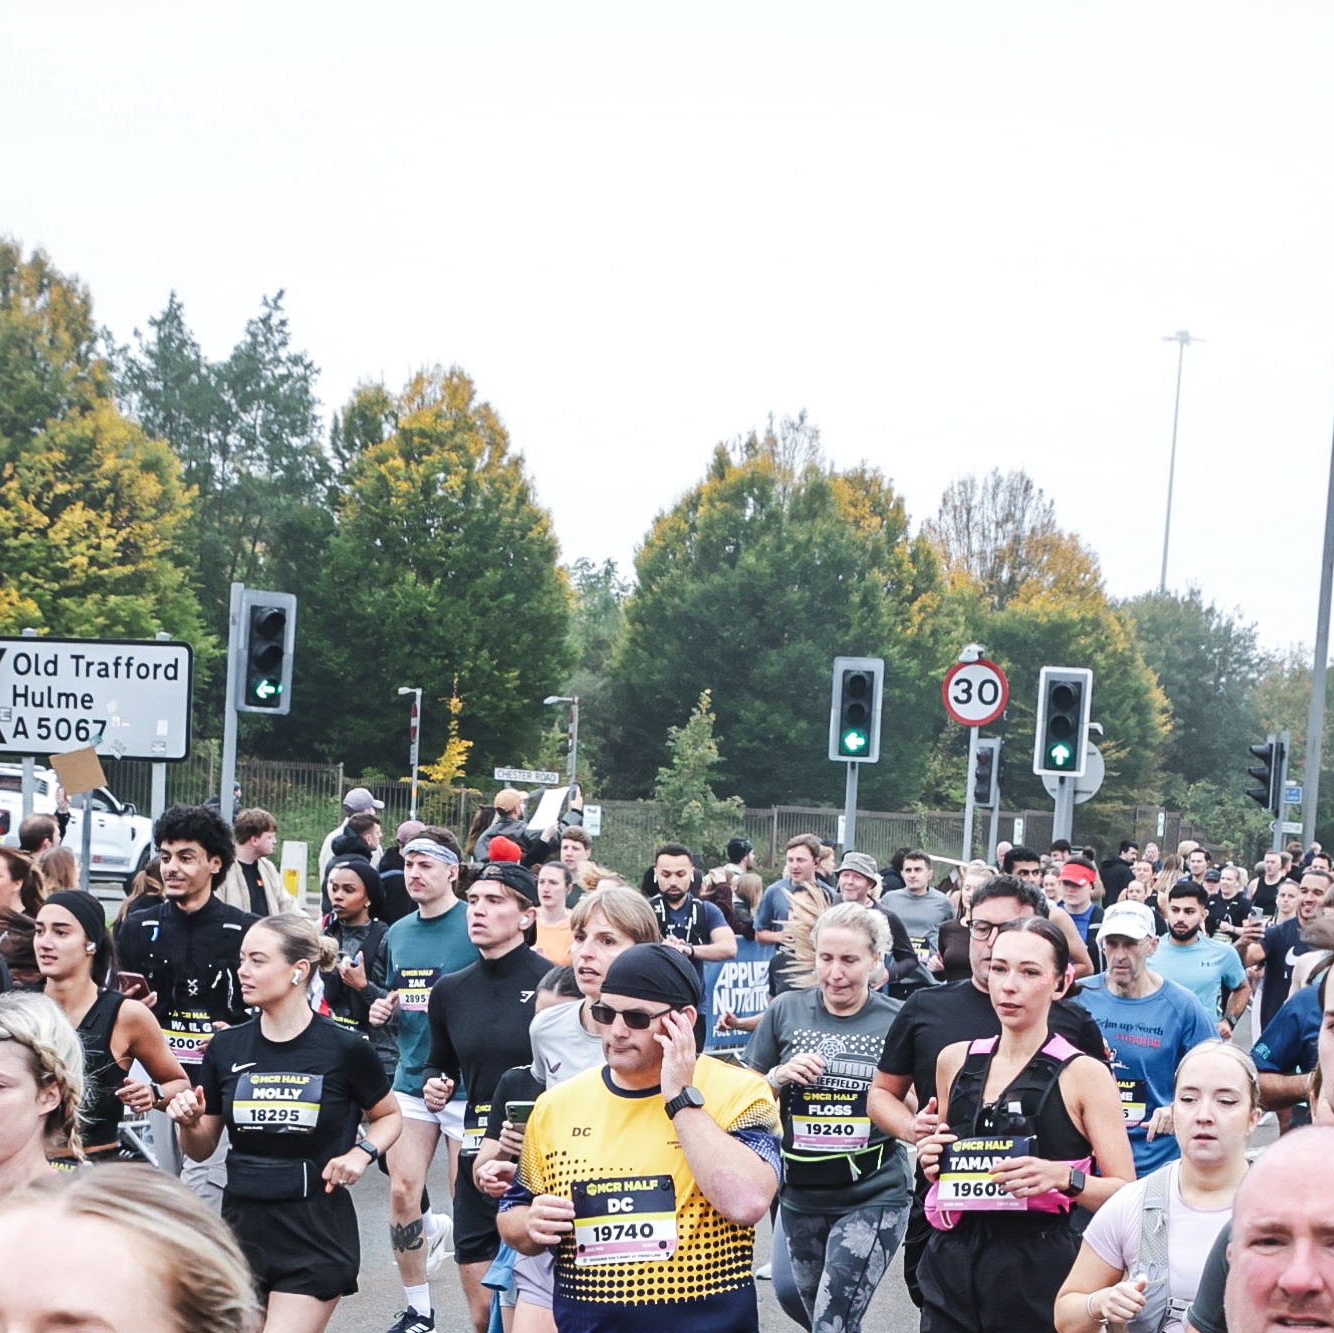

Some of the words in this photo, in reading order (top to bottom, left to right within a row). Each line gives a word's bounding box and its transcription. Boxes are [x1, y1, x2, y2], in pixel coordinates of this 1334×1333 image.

[13, 652, 58, 677] Old
[70, 654, 159, 681] Trafford
[12, 684, 94, 710] Hulme
[953, 678, 999, 705] 30
[12, 716, 29, 739] A
[36, 717, 107, 742] 5067
[497, 769, 532, 780] CHESTER
[535, 772, 557, 782] ROAD
[408, 978, 427, 988] ZAK
[252, 1087, 302, 1100] MOLLY
[249, 1109, 300, 1122] 18295
[808, 1105, 853, 1116] FLOSS
[572, 1127, 592, 1137] DC
[806, 1124, 855, 1136] 19240
[961, 1141, 983, 1151] MCR
[984, 1140, 1014, 1151] HALF
[598, 1182, 622, 1194] MCR
[623, 1179, 659, 1192] HALF
[607, 1197, 634, 1214] DC
[593, 1223, 654, 1242] 19740
